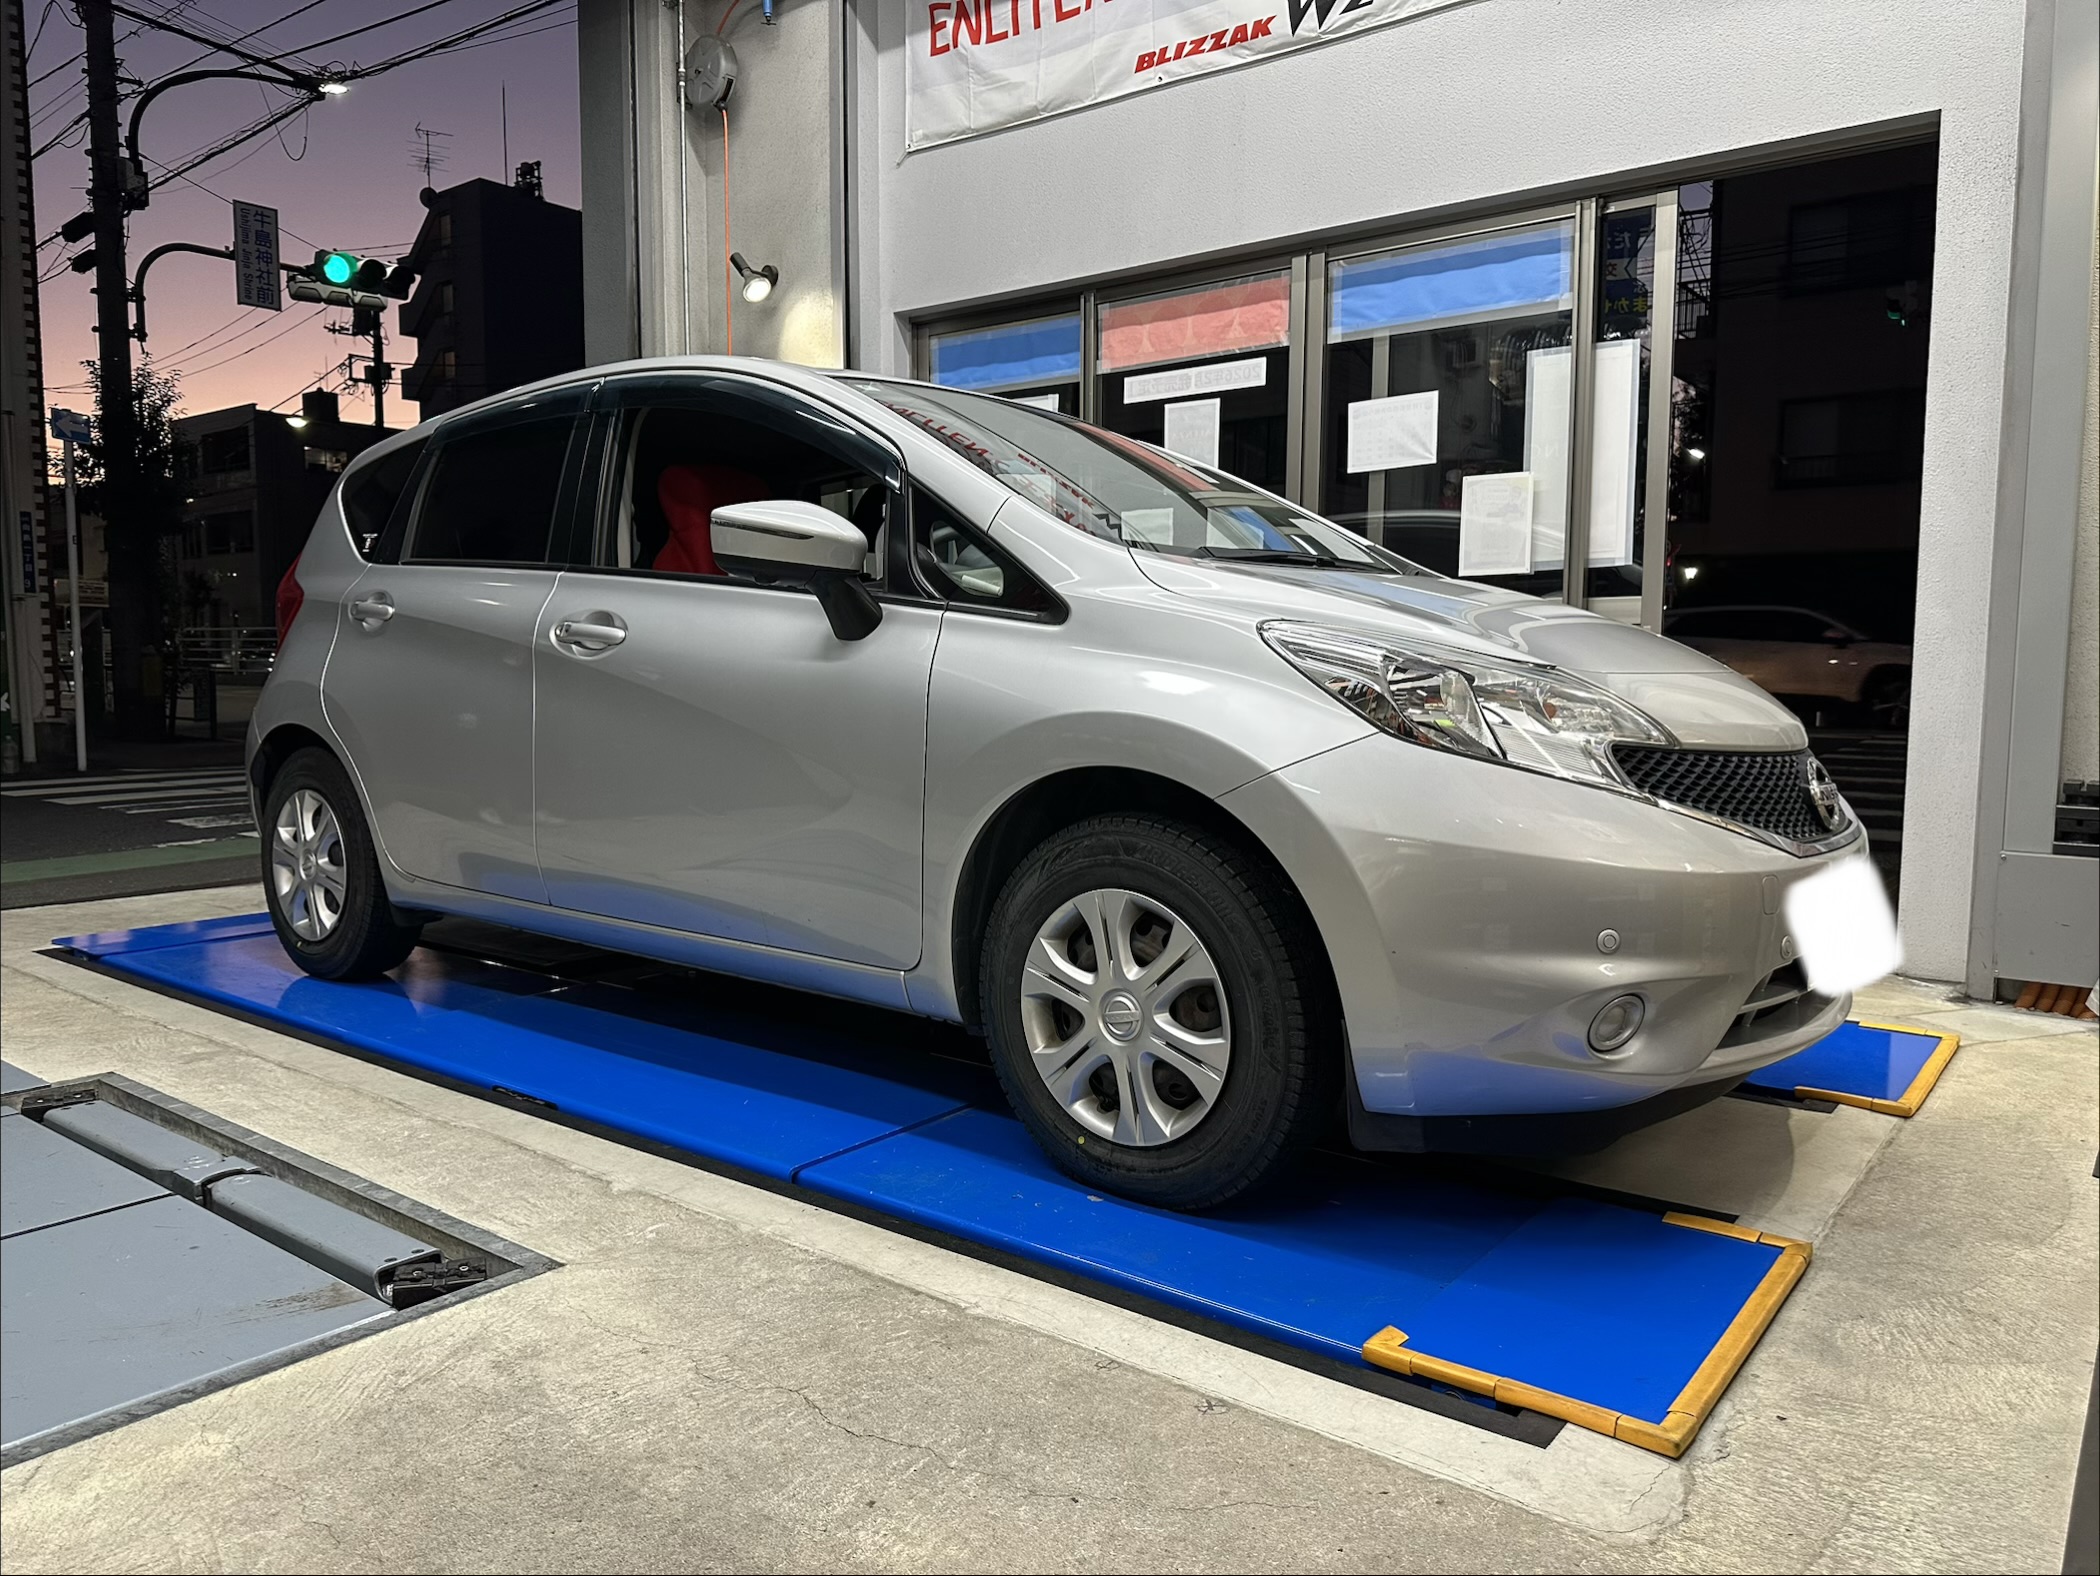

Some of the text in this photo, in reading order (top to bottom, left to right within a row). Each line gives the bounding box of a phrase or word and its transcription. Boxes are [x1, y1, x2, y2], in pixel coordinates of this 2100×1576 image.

[1134, 15, 1277, 74] BLIZZAK
[240, 208, 254, 300] Ushijima Jinja Shrine
[253, 210, 274, 305] 牛島神社前
